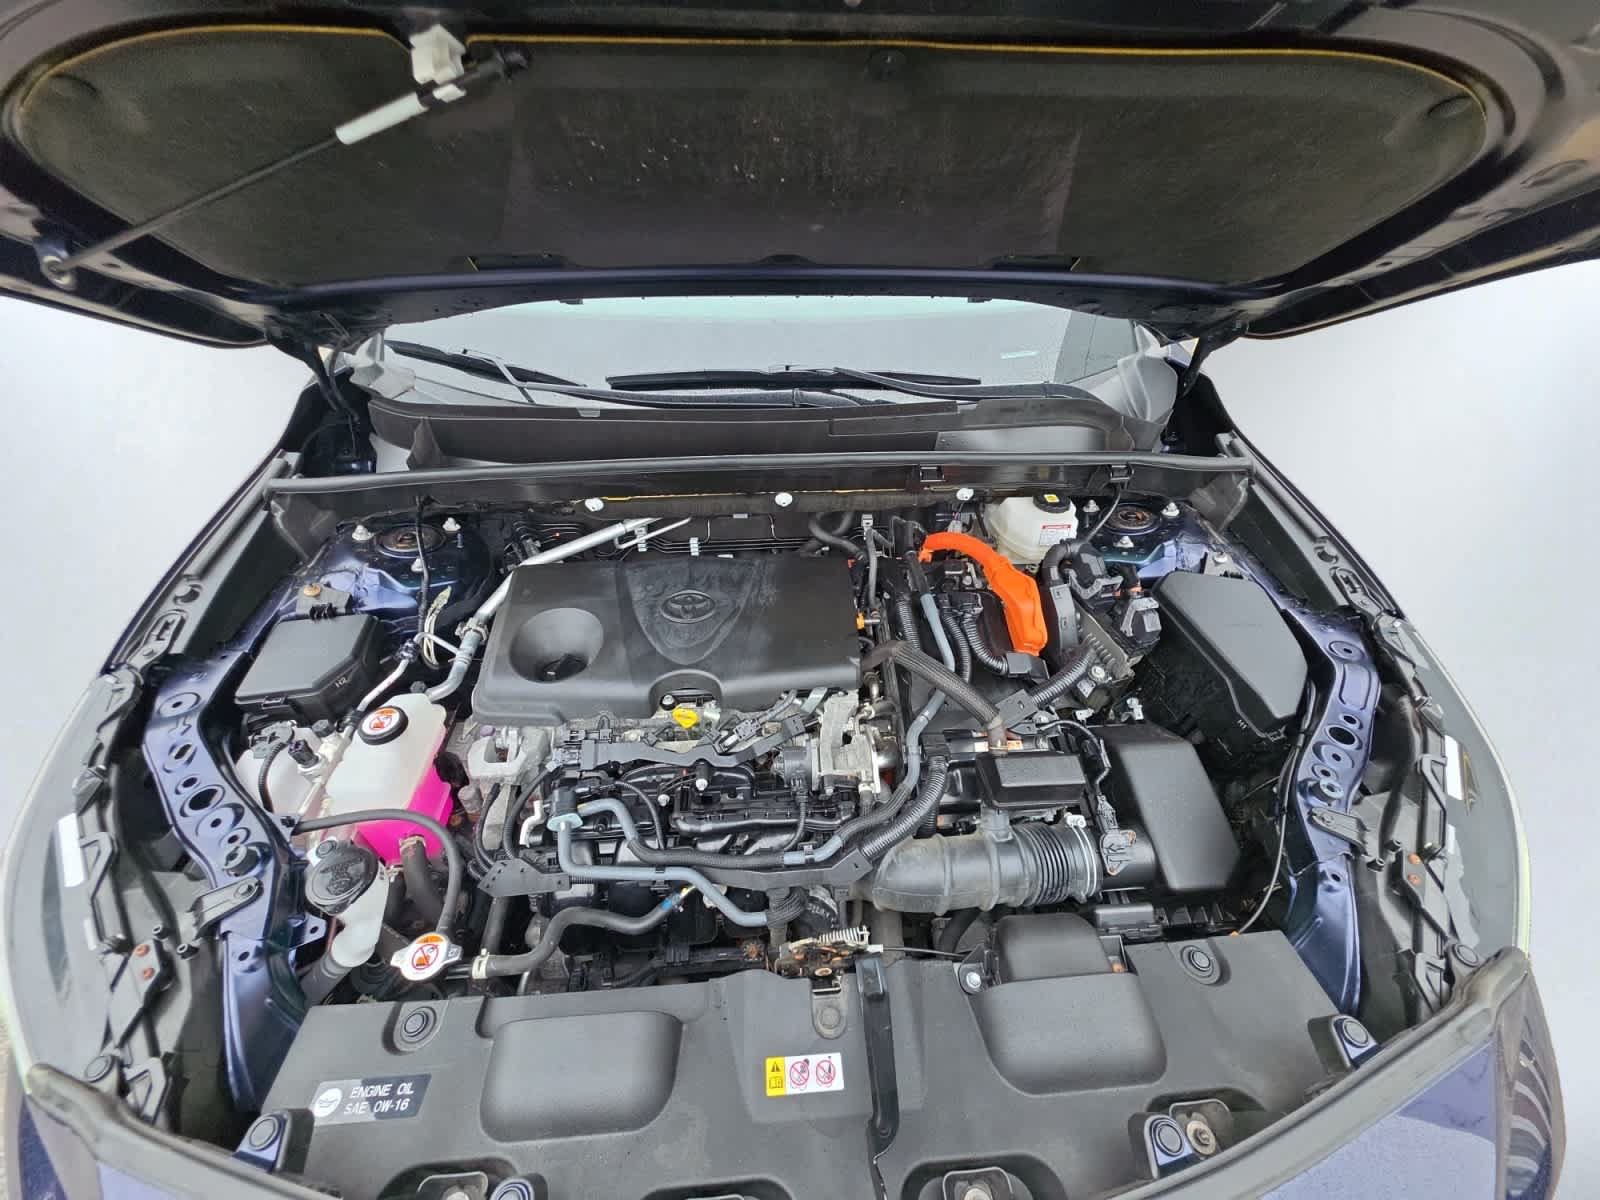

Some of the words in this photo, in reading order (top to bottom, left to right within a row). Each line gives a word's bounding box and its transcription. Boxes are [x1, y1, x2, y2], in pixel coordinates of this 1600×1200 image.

[349, 1083, 393, 1099] ENGINE
[396, 1082, 415, 1096] OIL
[343, 1102, 369, 1115] SAE
[372, 1098, 411, 1113] 0W-16
